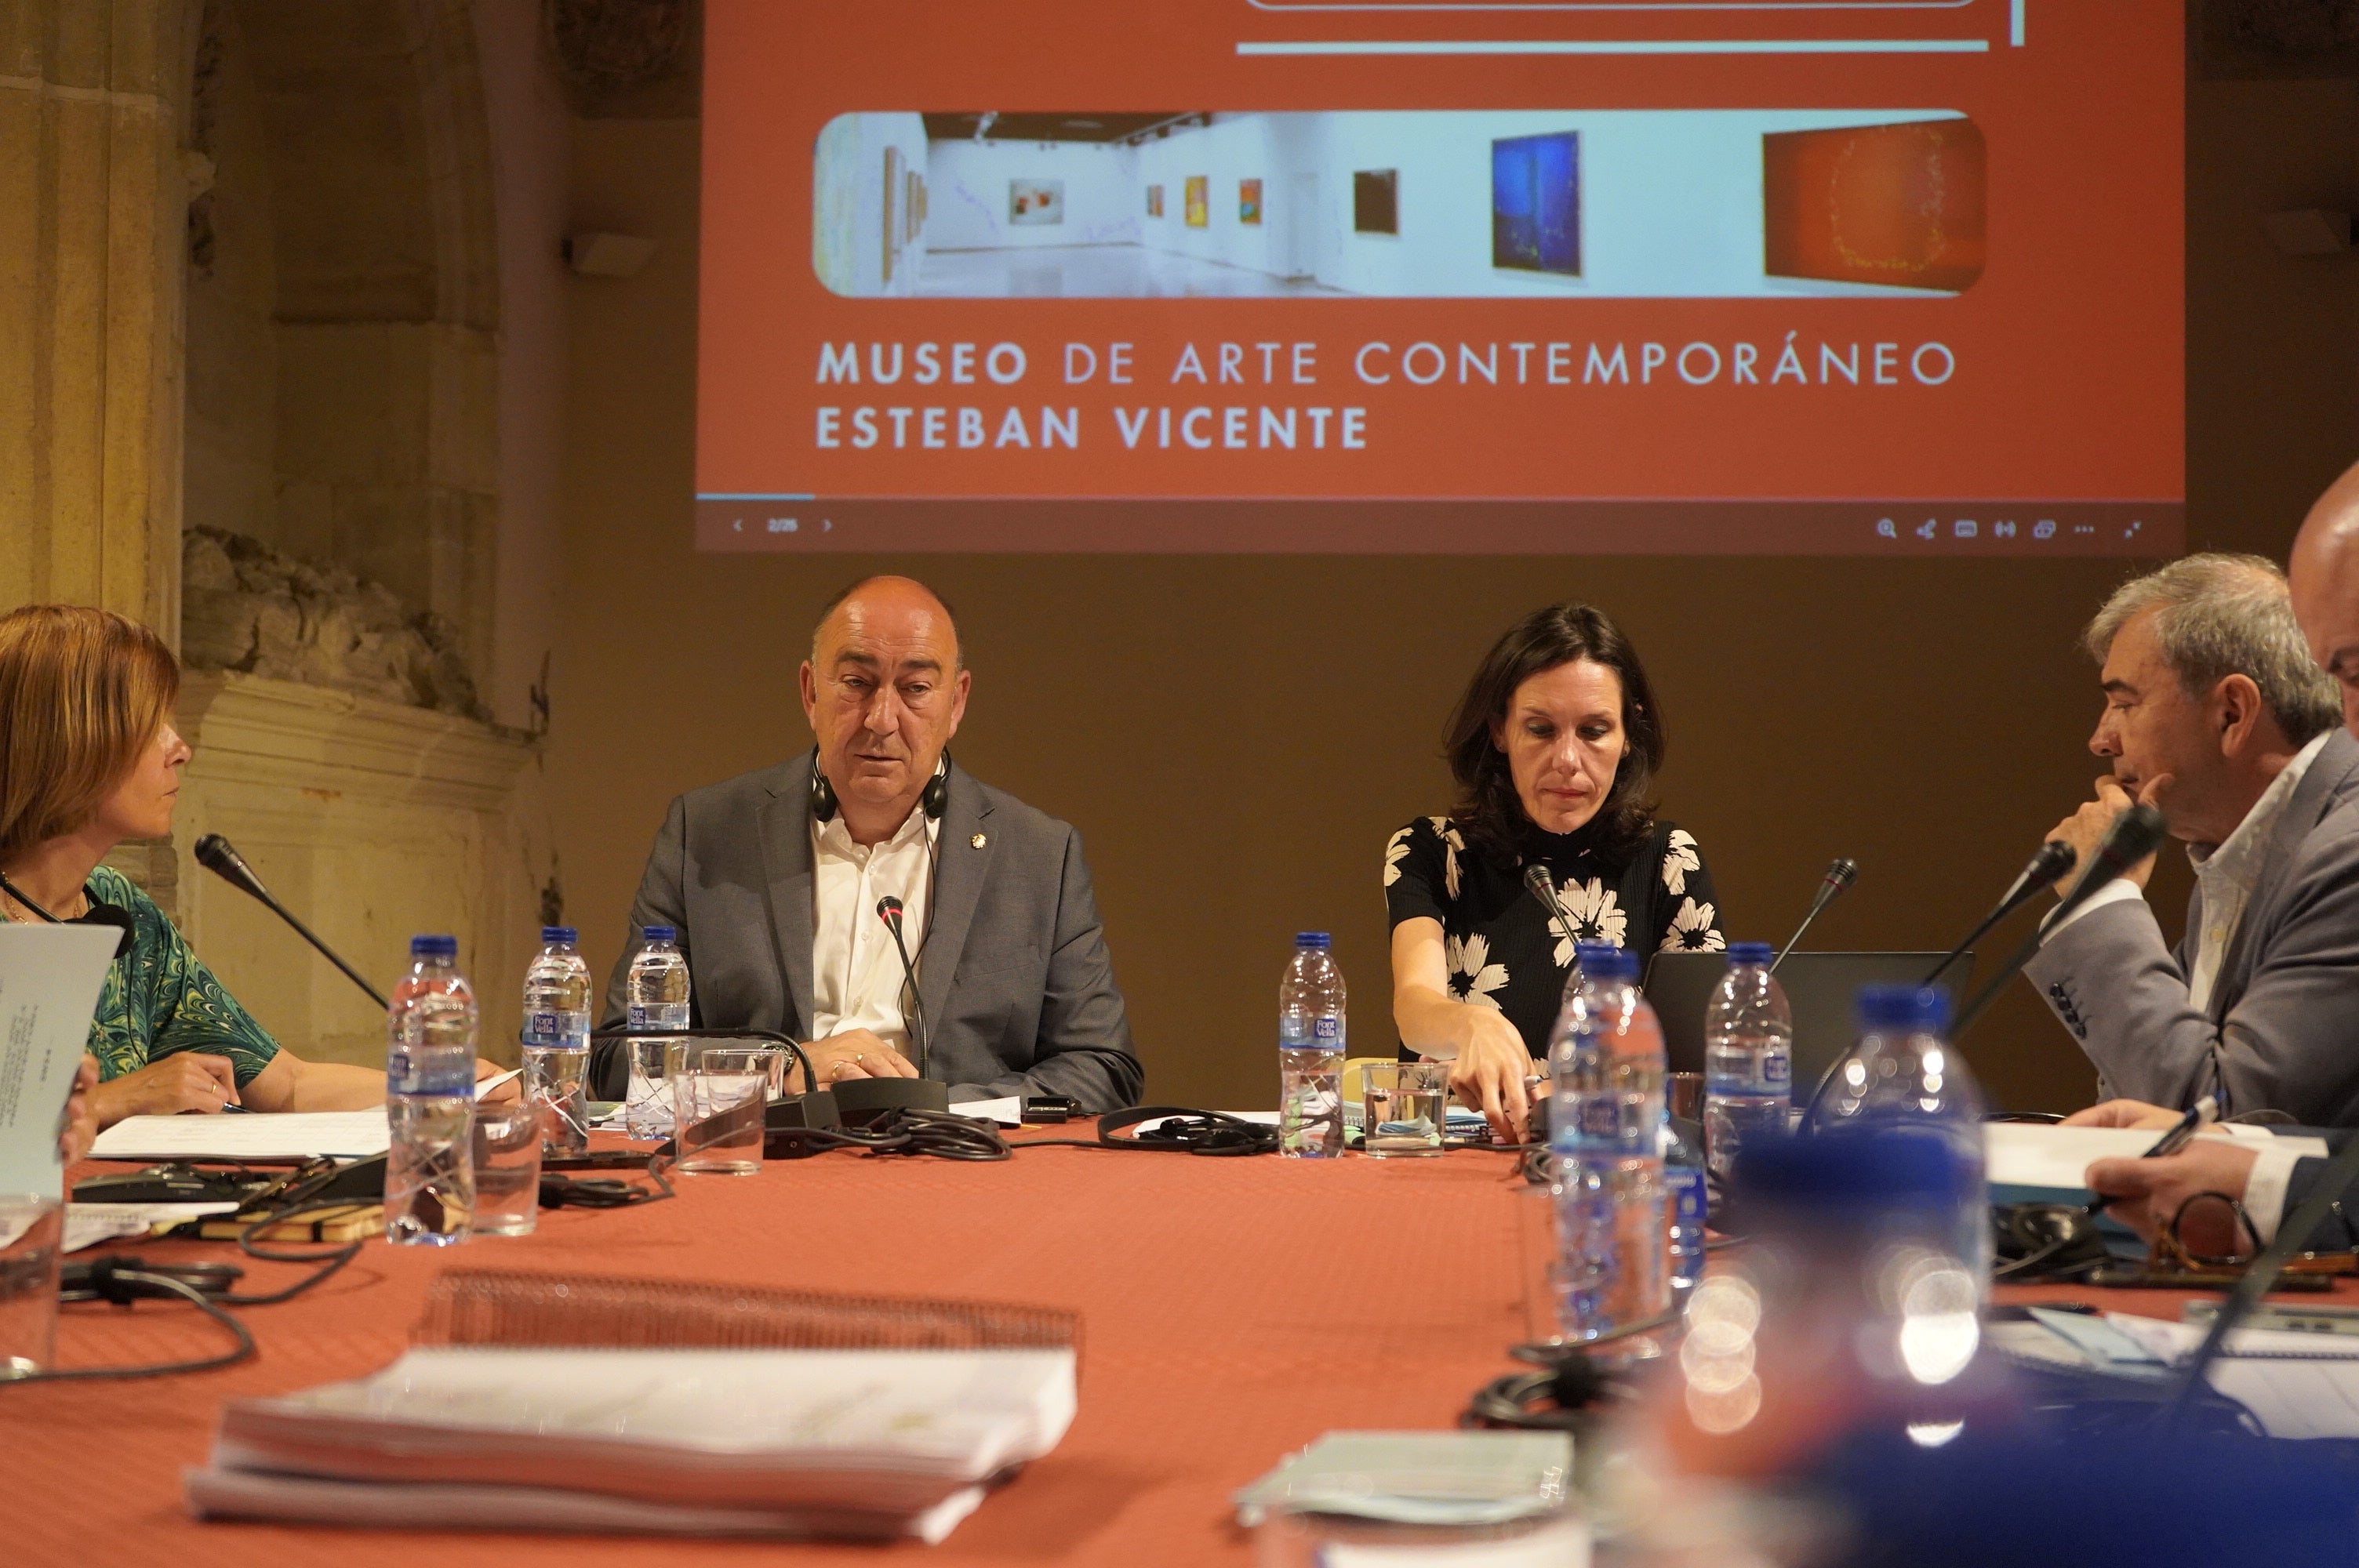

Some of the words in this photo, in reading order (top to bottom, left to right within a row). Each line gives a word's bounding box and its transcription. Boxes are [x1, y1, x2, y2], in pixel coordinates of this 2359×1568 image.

[815, 341, 1027, 385] MUSEO
[1063, 342, 1134, 385] DE
[1169, 342, 1317, 385] ARTE
[1354, 330, 1955, 386] CONTEMPORÁNEO
[815, 406, 1080, 449] ESTEBAN
[1112, 405, 1367, 449] VICENTE
[535, 1016, 554, 1025] Font
[1317, 1020, 1335, 1029] Font
[535, 1024, 554, 1033] Vella
[1317, 1028, 1335, 1036] Vella
